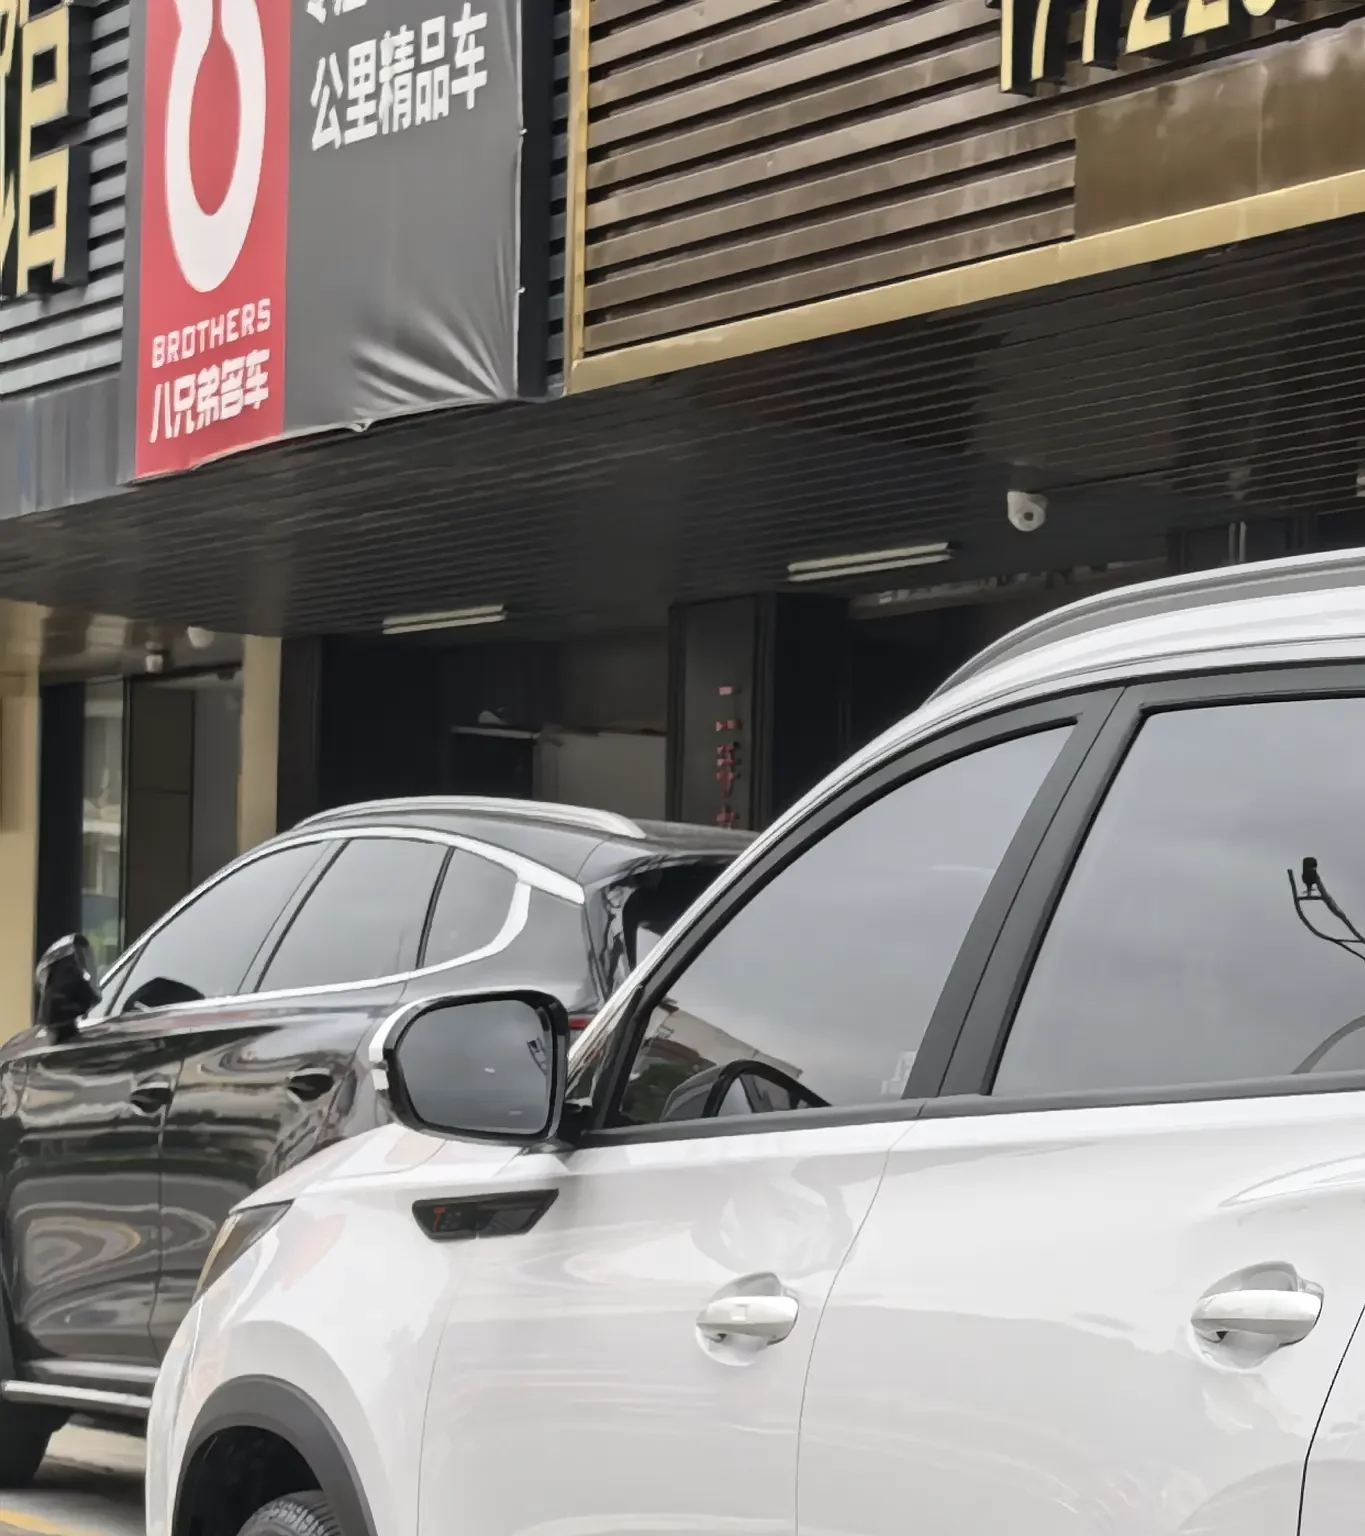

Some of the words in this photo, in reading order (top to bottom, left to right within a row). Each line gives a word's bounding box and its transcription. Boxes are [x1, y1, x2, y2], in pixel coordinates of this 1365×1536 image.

[310, 2, 488, 151] 公里精品车
[152, 298, 271, 368] BROTHERS
